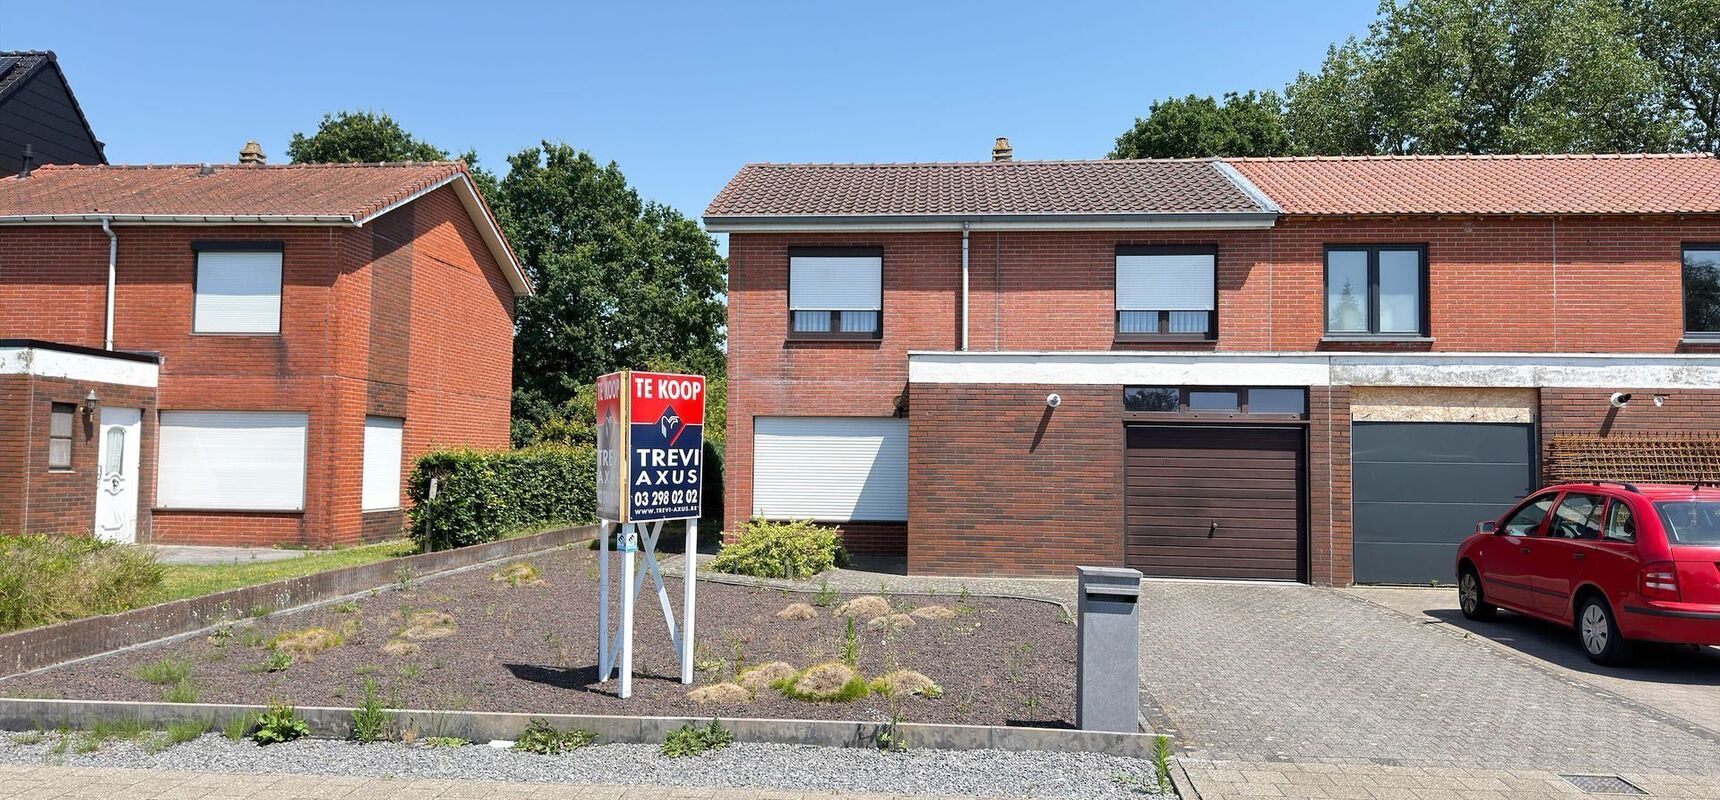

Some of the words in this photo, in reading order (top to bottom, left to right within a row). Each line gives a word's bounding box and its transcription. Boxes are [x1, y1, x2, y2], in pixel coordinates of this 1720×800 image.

[635, 377, 653, 398] TE
[658, 379, 702, 401] KOOP
[636, 448, 699, 467] TREVI
[635, 469, 698, 486] AXUS
[634, 491, 649, 507] 03
[651, 490, 670, 506] 298
[671, 489, 684, 504] 02
[686, 489, 698, 504] 02
